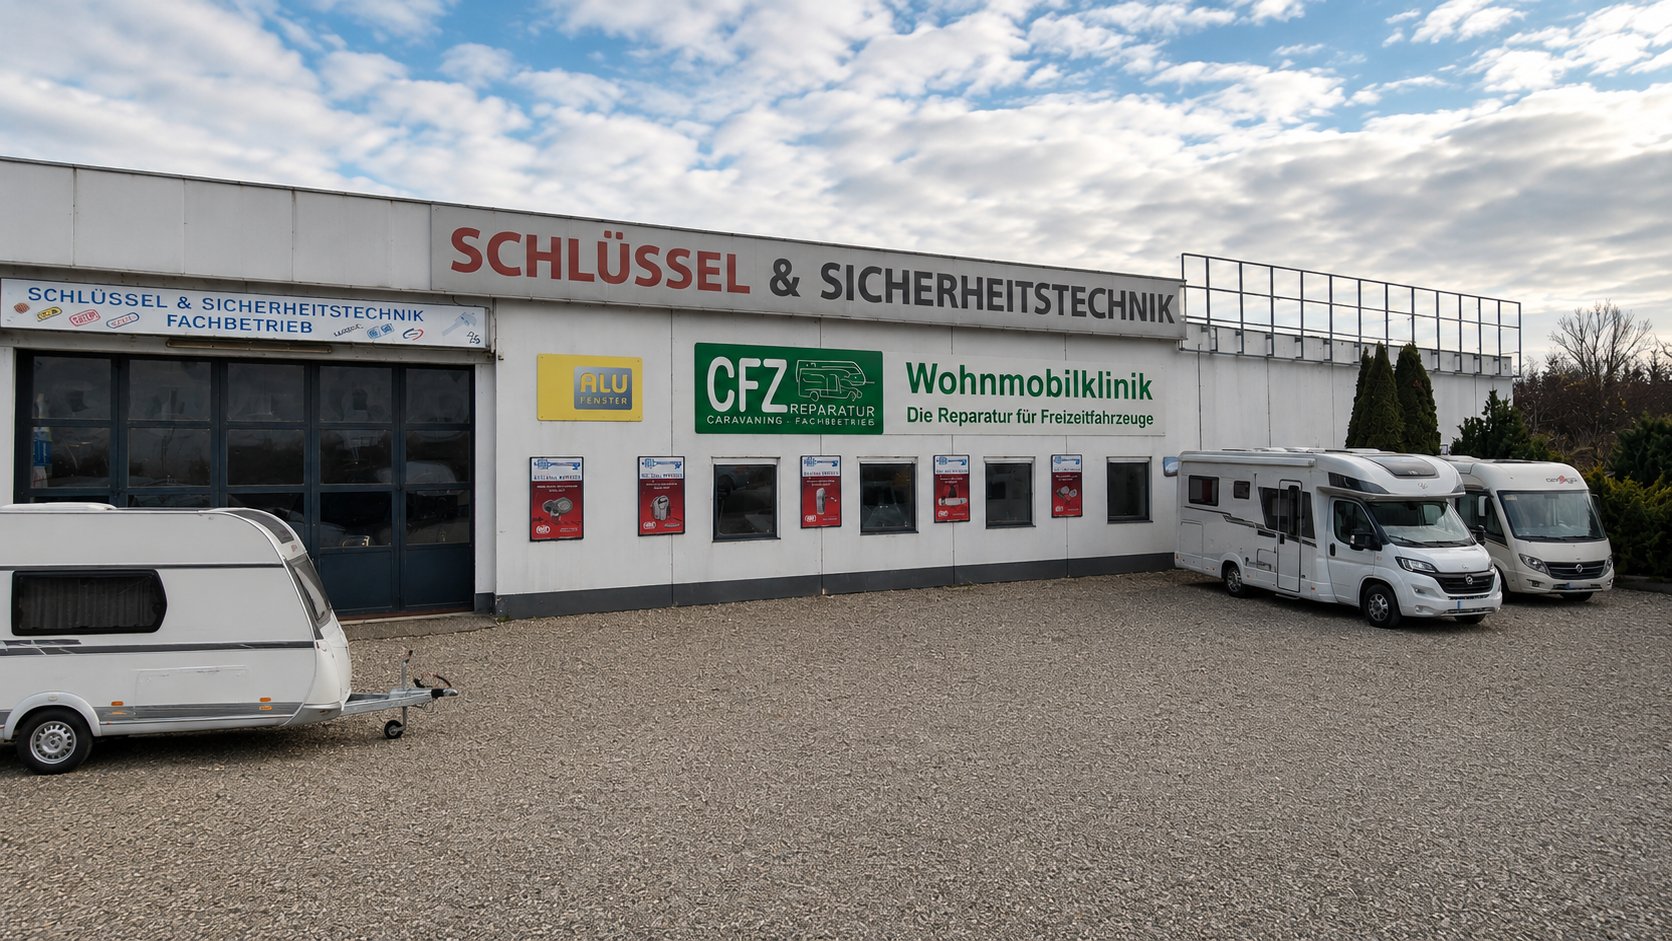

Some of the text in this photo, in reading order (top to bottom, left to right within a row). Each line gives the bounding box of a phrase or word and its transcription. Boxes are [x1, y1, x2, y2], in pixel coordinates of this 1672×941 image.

[450, 226, 1175, 324] SCHLÜSSEL & SICHERHEITSTECHNIK
[28, 287, 424, 322] SCHLÜSSEL & SICHERHEITSTECHNIK
[167, 314, 313, 334] FACHBETRIEB
[580, 372, 628, 394] ALU
[707, 356, 789, 413] CFZ
[905, 361, 1154, 400] Wohnmobilklinik
[580, 396, 628, 405] FENSTER
[790, 403, 875, 417] REPARATUR
[706, 415, 783, 425] CARAVANING
[907, 406, 1154, 429] Die Reparatur für Freizeitfahrzeuge
